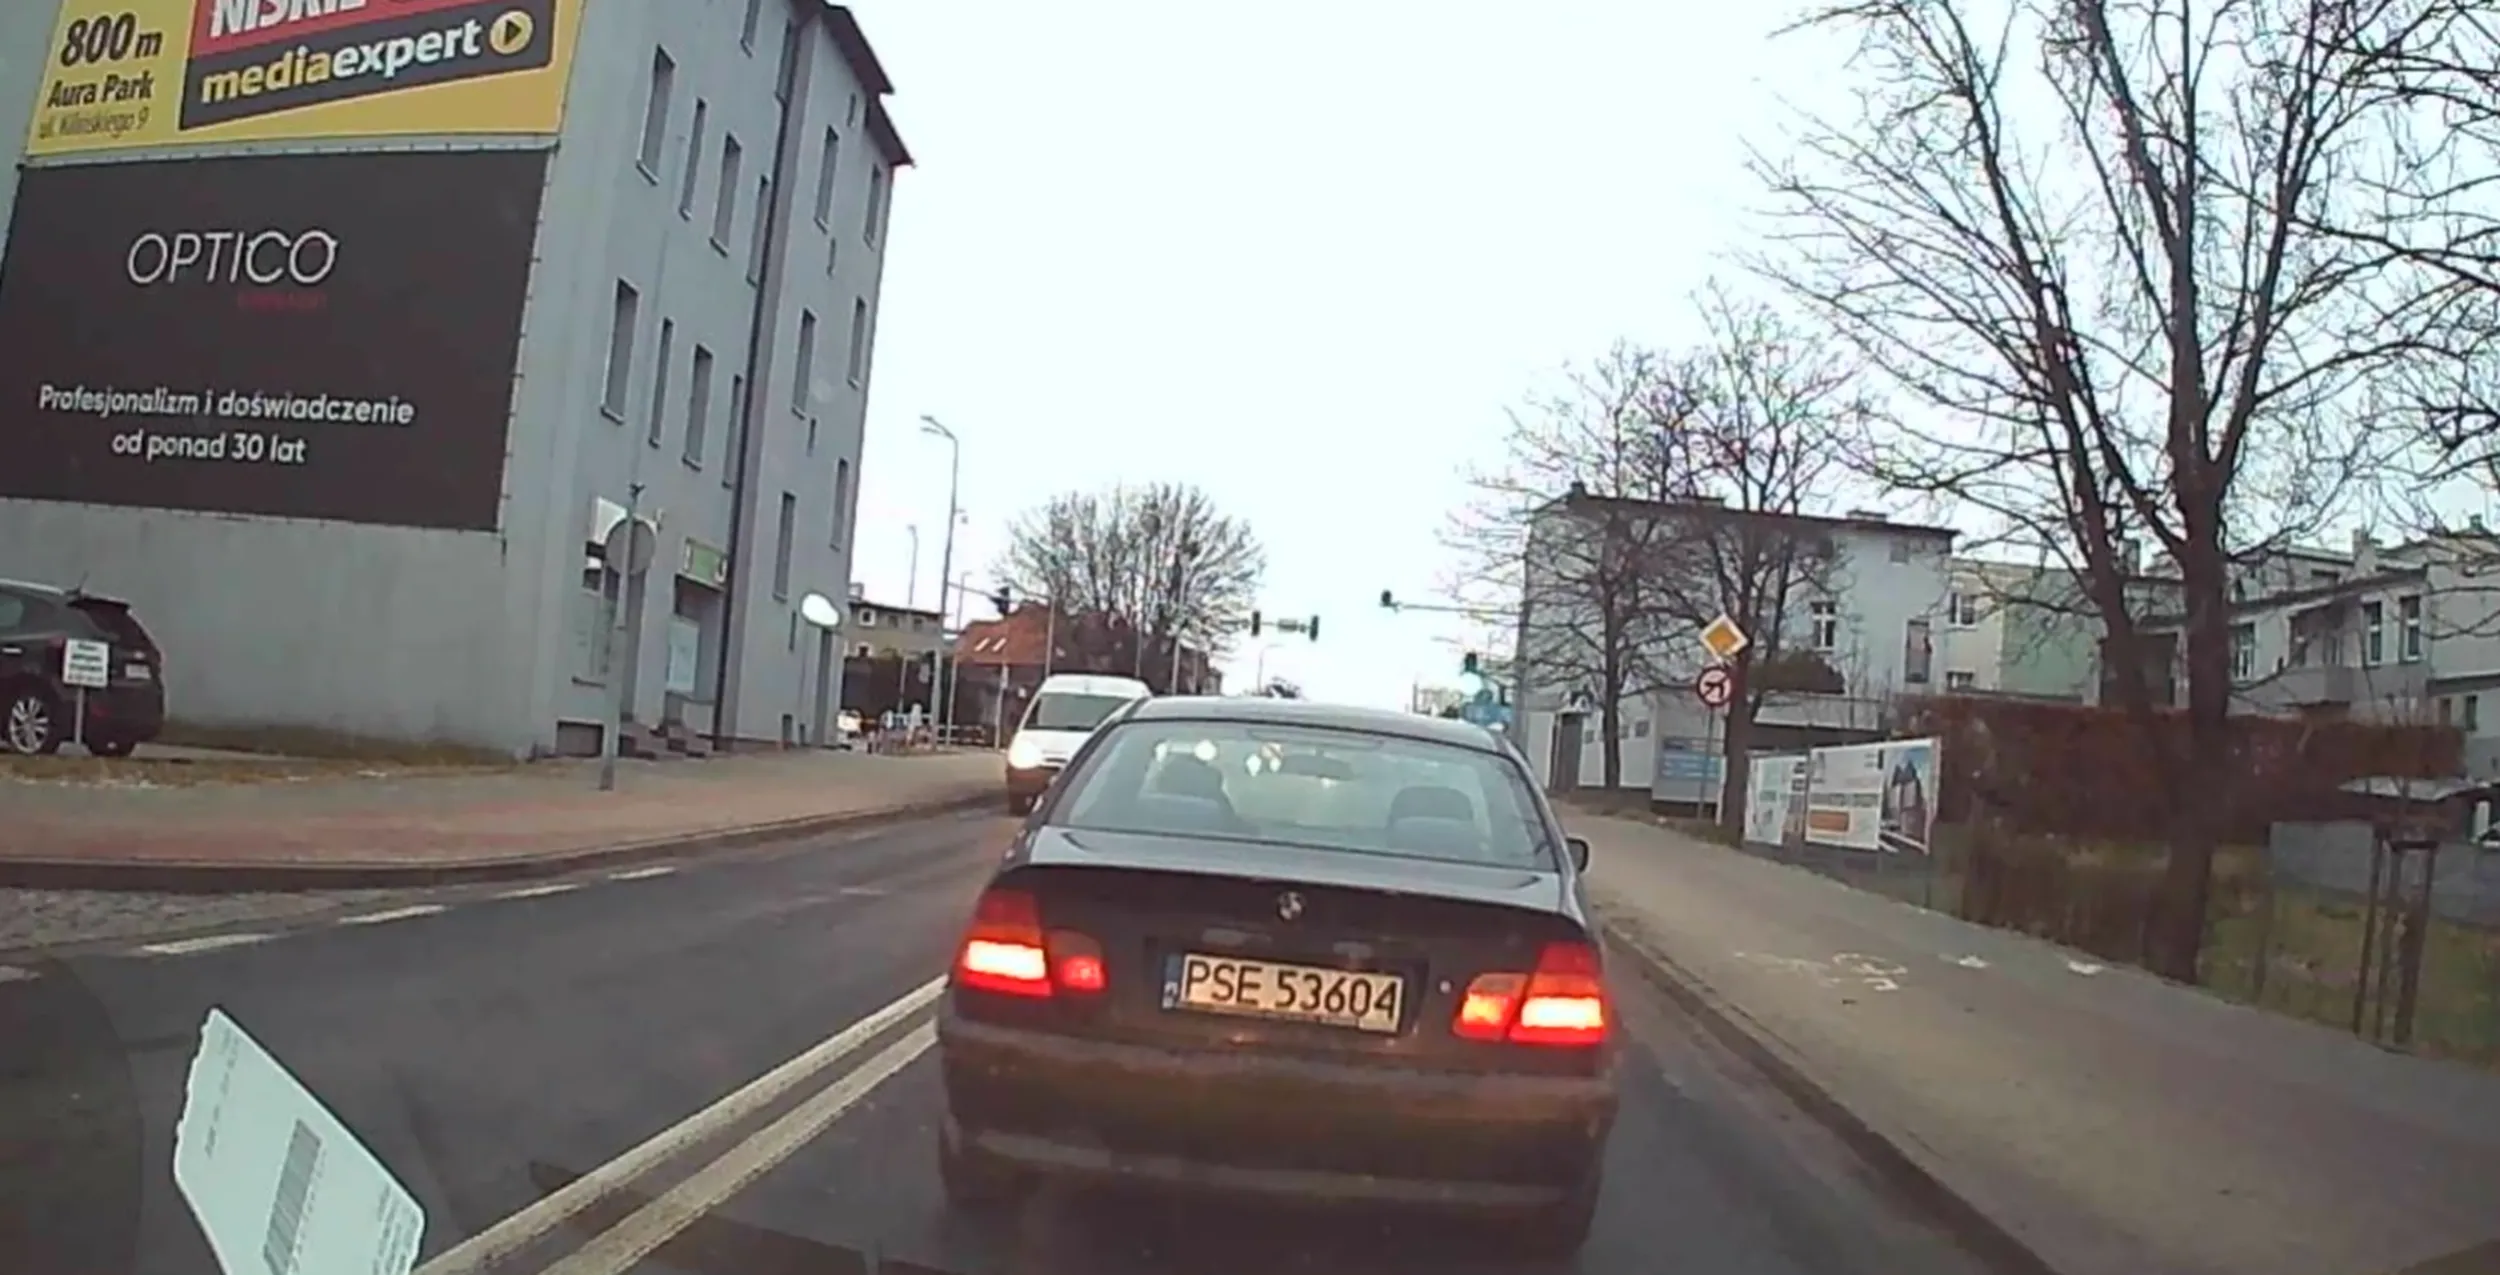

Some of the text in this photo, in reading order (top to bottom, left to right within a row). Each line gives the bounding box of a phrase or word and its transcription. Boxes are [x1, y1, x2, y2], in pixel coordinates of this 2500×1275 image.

[60, 12, 163, 67] 800 m
[209, 0, 367, 38] NIS
[201, 18, 484, 104] mediaexpert
[47, 70, 154, 108] Aura Park
[136, 106, 150, 130] 9
[127, 230, 338, 285] OPTICO
[38, 384, 415, 425] Profesjonalizm i doświadczenie
[111, 429, 307, 464] od ponad 30 lat
[1186, 960, 1397, 1022] PSE 53604
